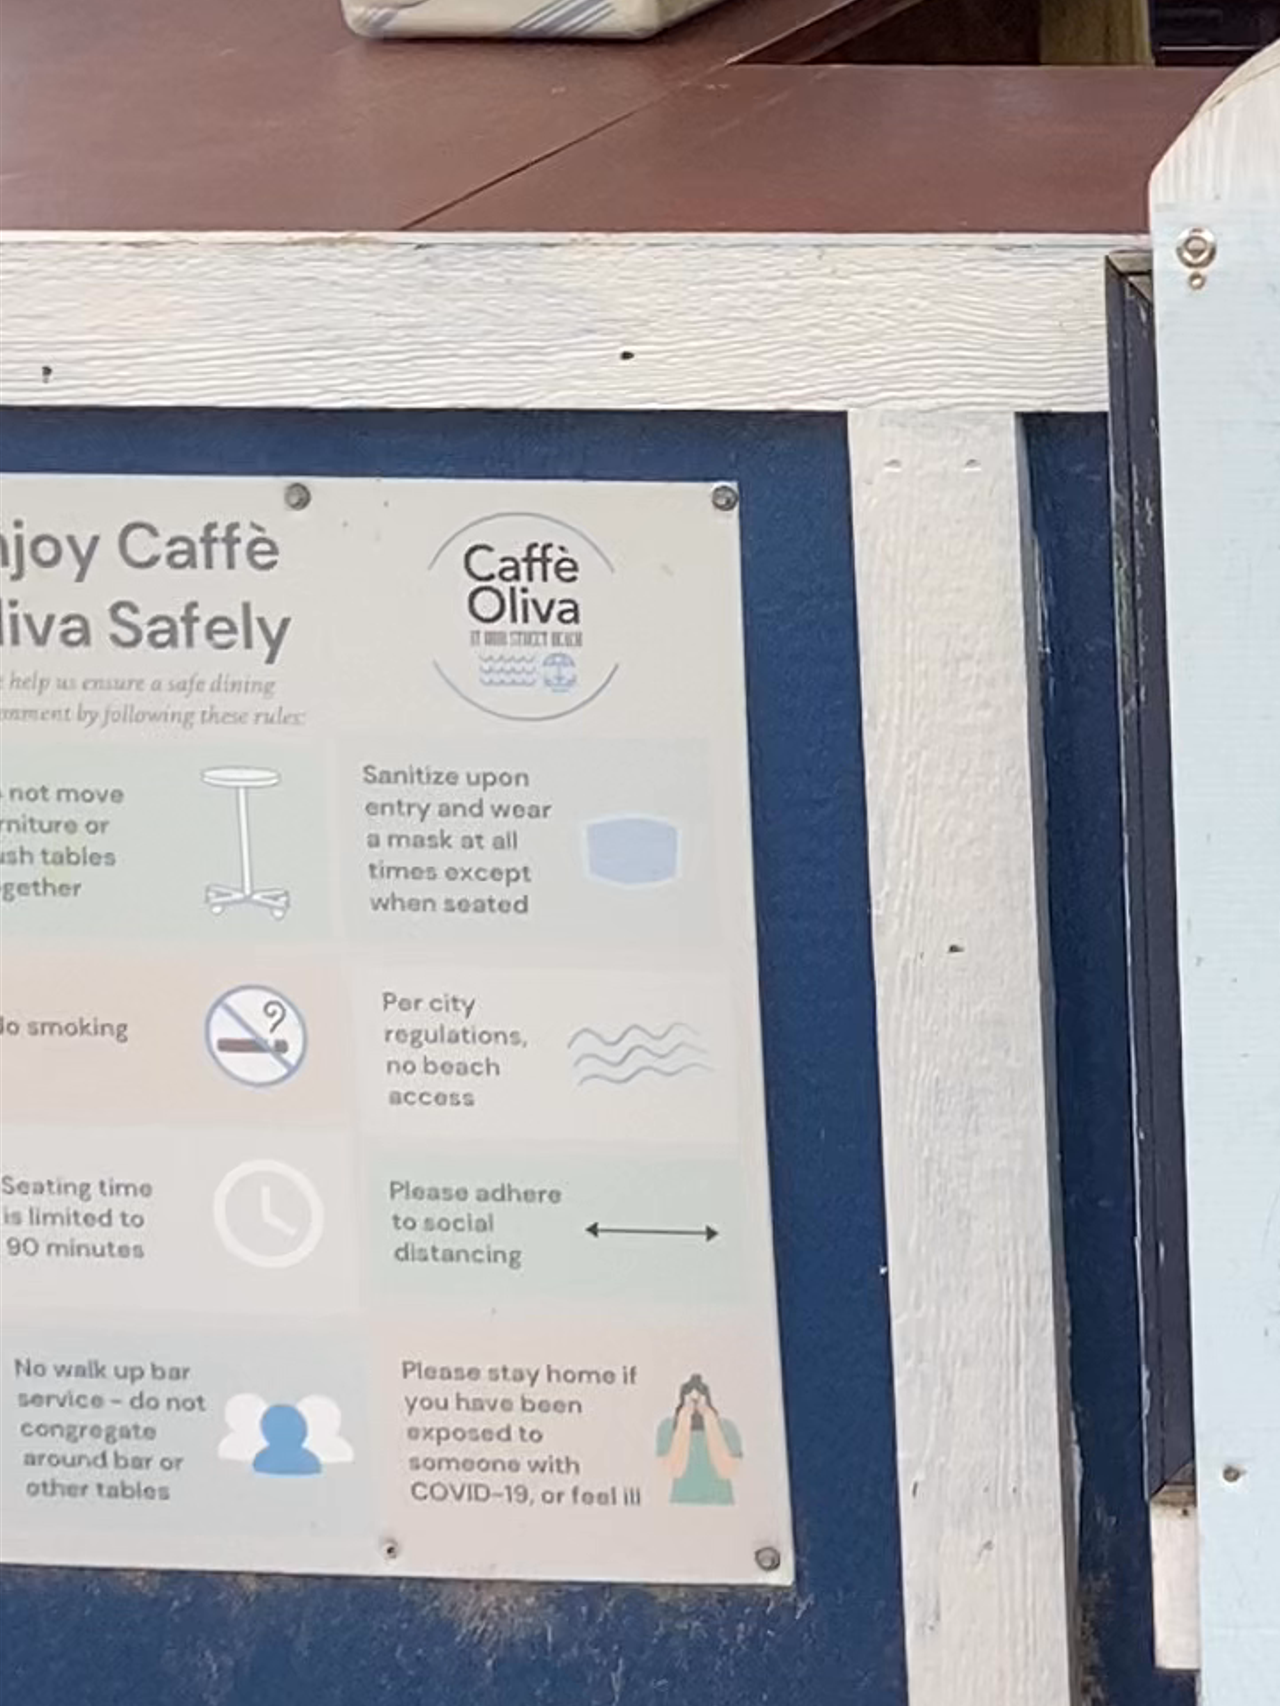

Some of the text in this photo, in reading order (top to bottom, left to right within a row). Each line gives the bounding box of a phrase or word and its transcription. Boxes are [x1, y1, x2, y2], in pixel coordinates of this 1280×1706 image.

[117, 519, 281, 571] Caffè
[463, 541, 580, 583] Caffè
[467, 585, 580, 625] Oliva
[107, 598, 292, 664] Safely
[208, 672, 277, 699] dining
[76, 702, 249, 730] by following these
[362, 762, 530, 793] Sanitize upon
[9, 784, 125, 804] not move
[364, 797, 553, 823] entry and wear
[84, 819, 110, 836] or
[366, 827, 519, 852] a mask at all
[40, 845, 118, 867] tables
[368, 860, 533, 887] times except
[370, 893, 530, 915] when seated
[382, 991, 477, 1019] Per city
[27, 1016, 129, 1044] smoking
[383, 1024, 528, 1050] regulations,
[386, 1054, 501, 1077] no beach
[388, 1090, 476, 1108] access
[1, 1174, 154, 1202] Seating time
[389, 1180, 562, 1205] Please adhere
[3, 1207, 146, 1228] is limited to
[392, 1211, 495, 1234] to social
[6, 1238, 146, 1259] 90 minutes
[393, 1242, 523, 1269] distancing
[14, 1358, 191, 1384] No walk up bar
[401, 1360, 638, 1387] Please stay home if
[17, 1390, 207, 1413] service do not
[404, 1392, 583, 1416] you have been
[20, 1421, 157, 1445] congregate
[406, 1424, 544, 1446] exposed to
[23, 1449, 184, 1471] around bar or
[408, 1454, 580, 1475] someone with
[26, 1478, 171, 1501] other tables
[541, 1488, 565, 1504] or
[572, 1485, 617, 1506] feel
[623, 1485, 641, 1507] ill
